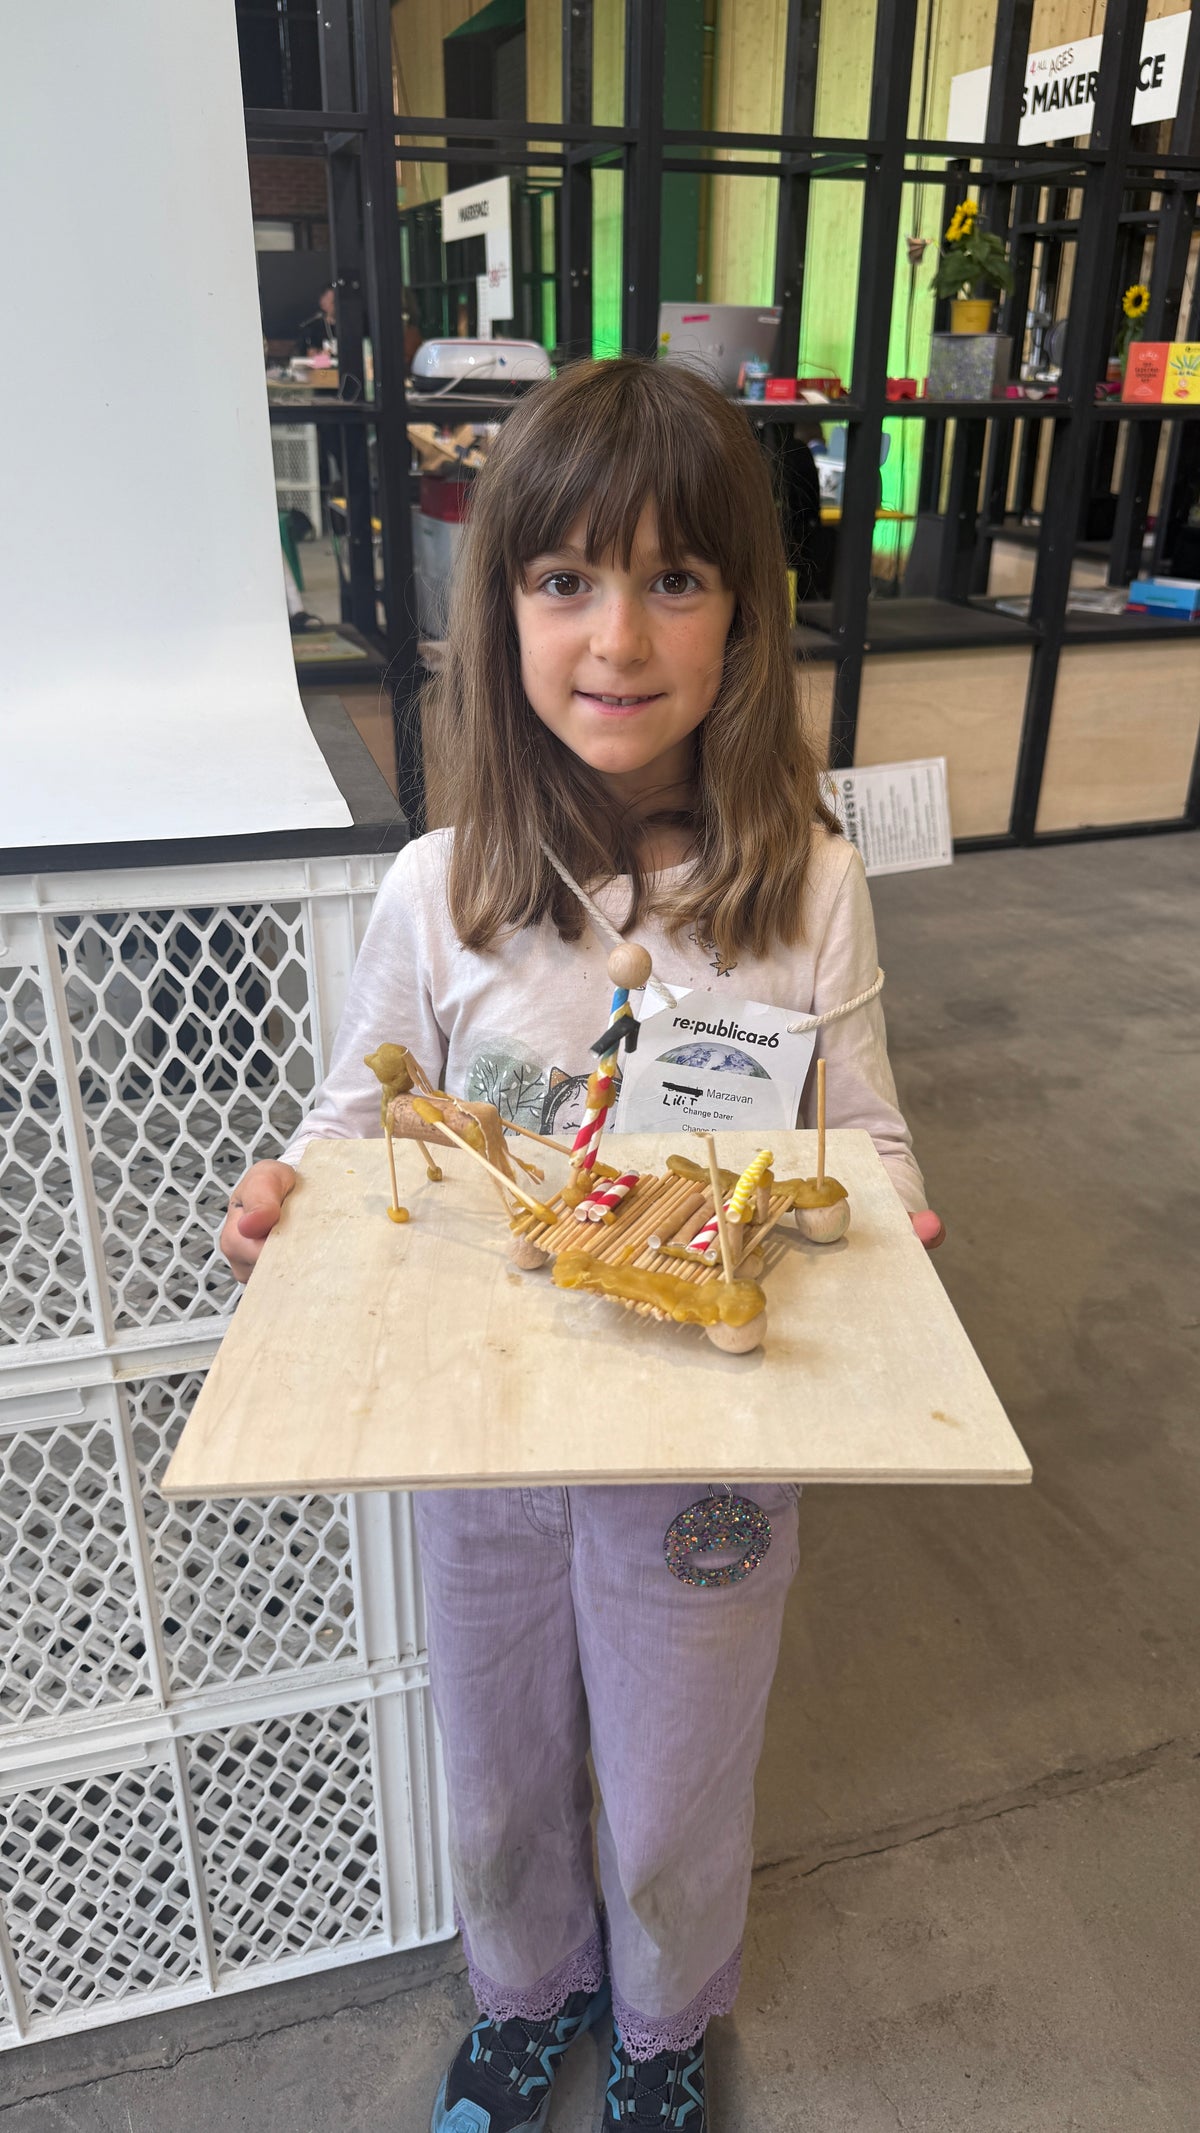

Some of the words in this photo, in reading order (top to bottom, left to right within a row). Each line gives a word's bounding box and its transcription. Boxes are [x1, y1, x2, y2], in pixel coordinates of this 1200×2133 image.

[1049, 47, 1075, 76] AGES
[672, 1016, 780, 1048] re:publica26
[707, 1089, 753, 1104] Marzavan
[683, 1107, 712, 1118] Change
[713, 1111, 734, 1120] Darer
